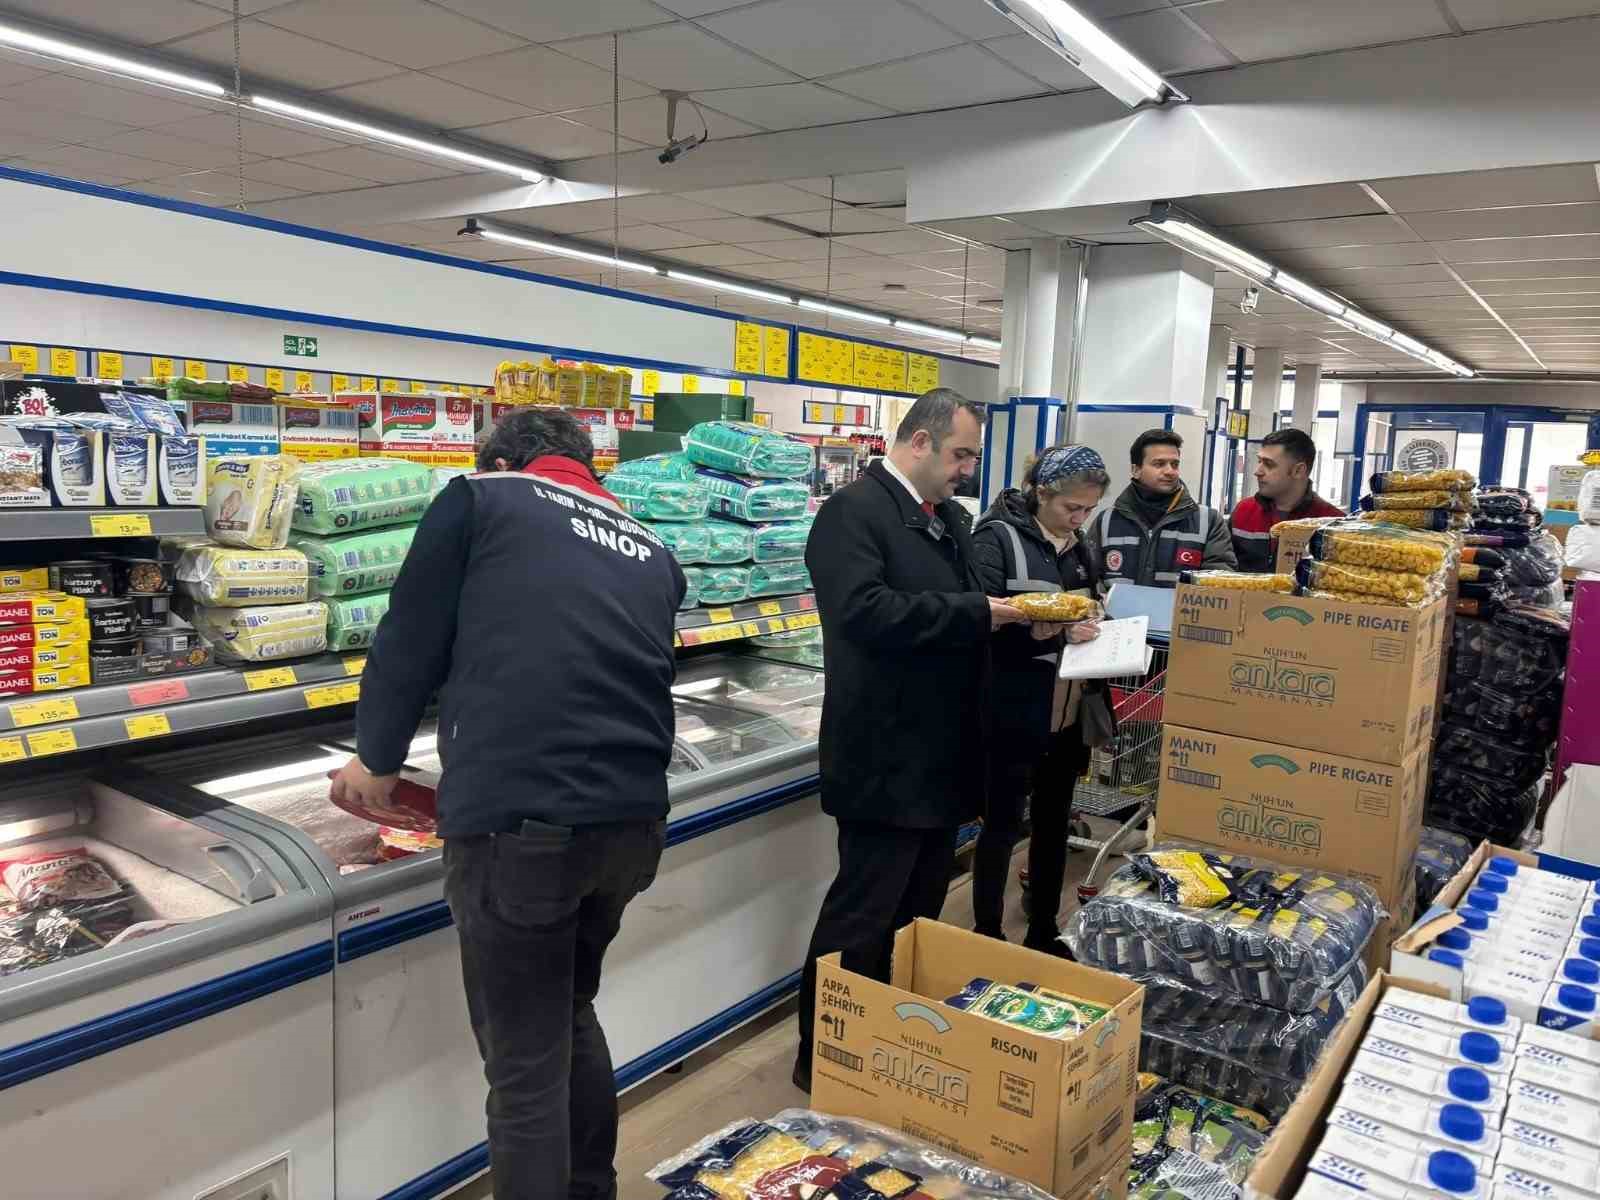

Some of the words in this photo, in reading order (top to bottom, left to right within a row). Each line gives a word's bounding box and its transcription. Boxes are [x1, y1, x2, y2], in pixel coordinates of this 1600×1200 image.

[569, 517, 652, 562] SİNOP
[37, 607, 55, 618] TON
[1323, 611, 1353, 626] PIPE
[1356, 612, 1409, 633] RIGATE
[40, 629, 59, 641] TON
[38, 652, 57, 664] TON
[38, 675, 57, 686] TON
[1229, 659, 1337, 700] ankara
[1169, 736, 1217, 756] MANTI
[1309, 762, 1337, 778] PIPE
[1342, 768, 1394, 788] RIGATE
[1217, 801, 1322, 849] ankara
[822, 978, 850, 997] ARPA
[991, 1037, 1038, 1063] RISONI
